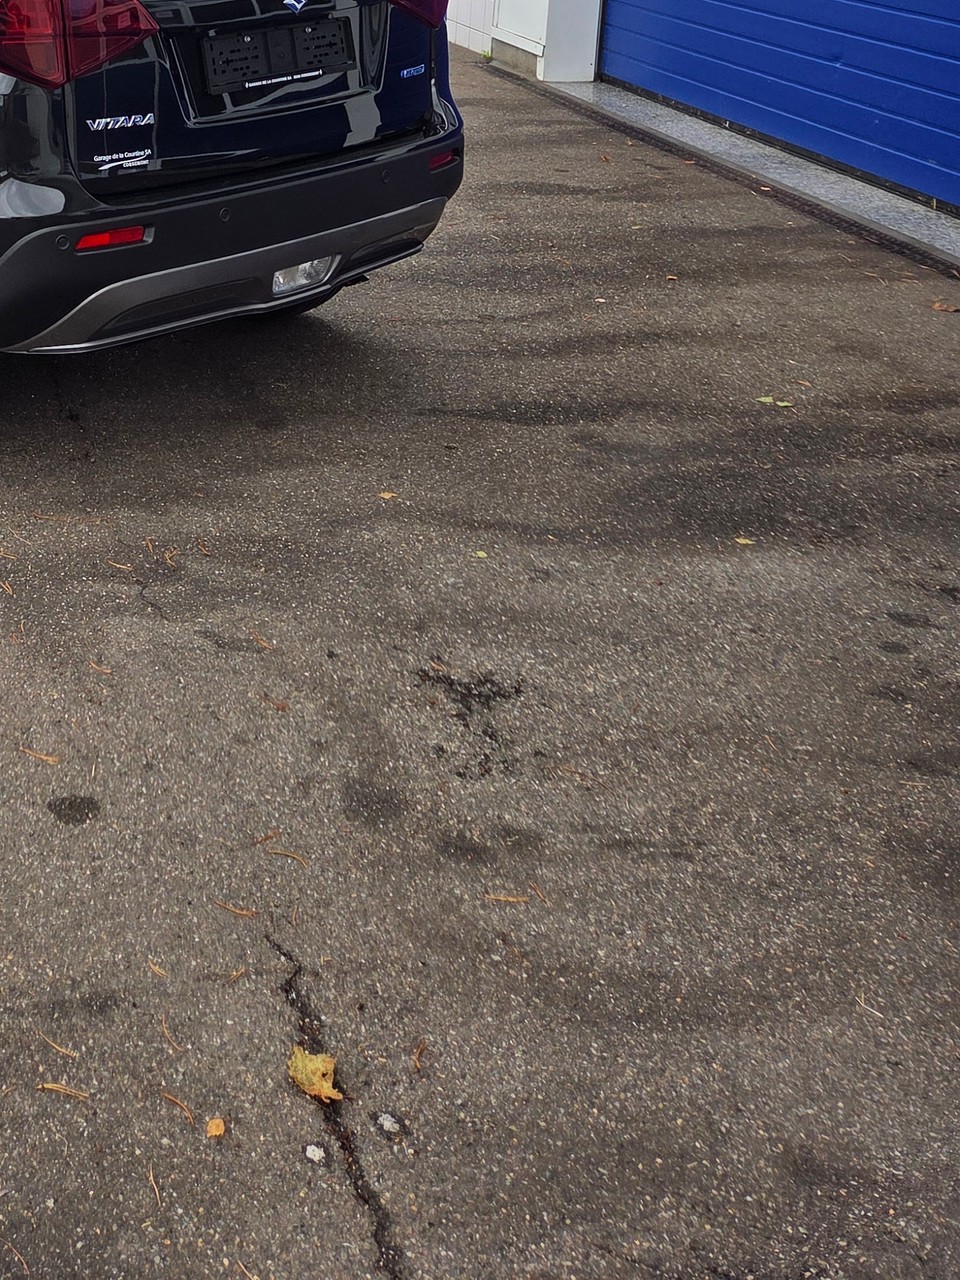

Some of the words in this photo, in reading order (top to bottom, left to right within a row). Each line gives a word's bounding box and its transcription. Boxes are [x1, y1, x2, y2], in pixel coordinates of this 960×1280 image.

[86, 112, 155, 131] VITARA
[93, 154, 112, 162] Garage
[124, 149, 145, 158] Courtine
